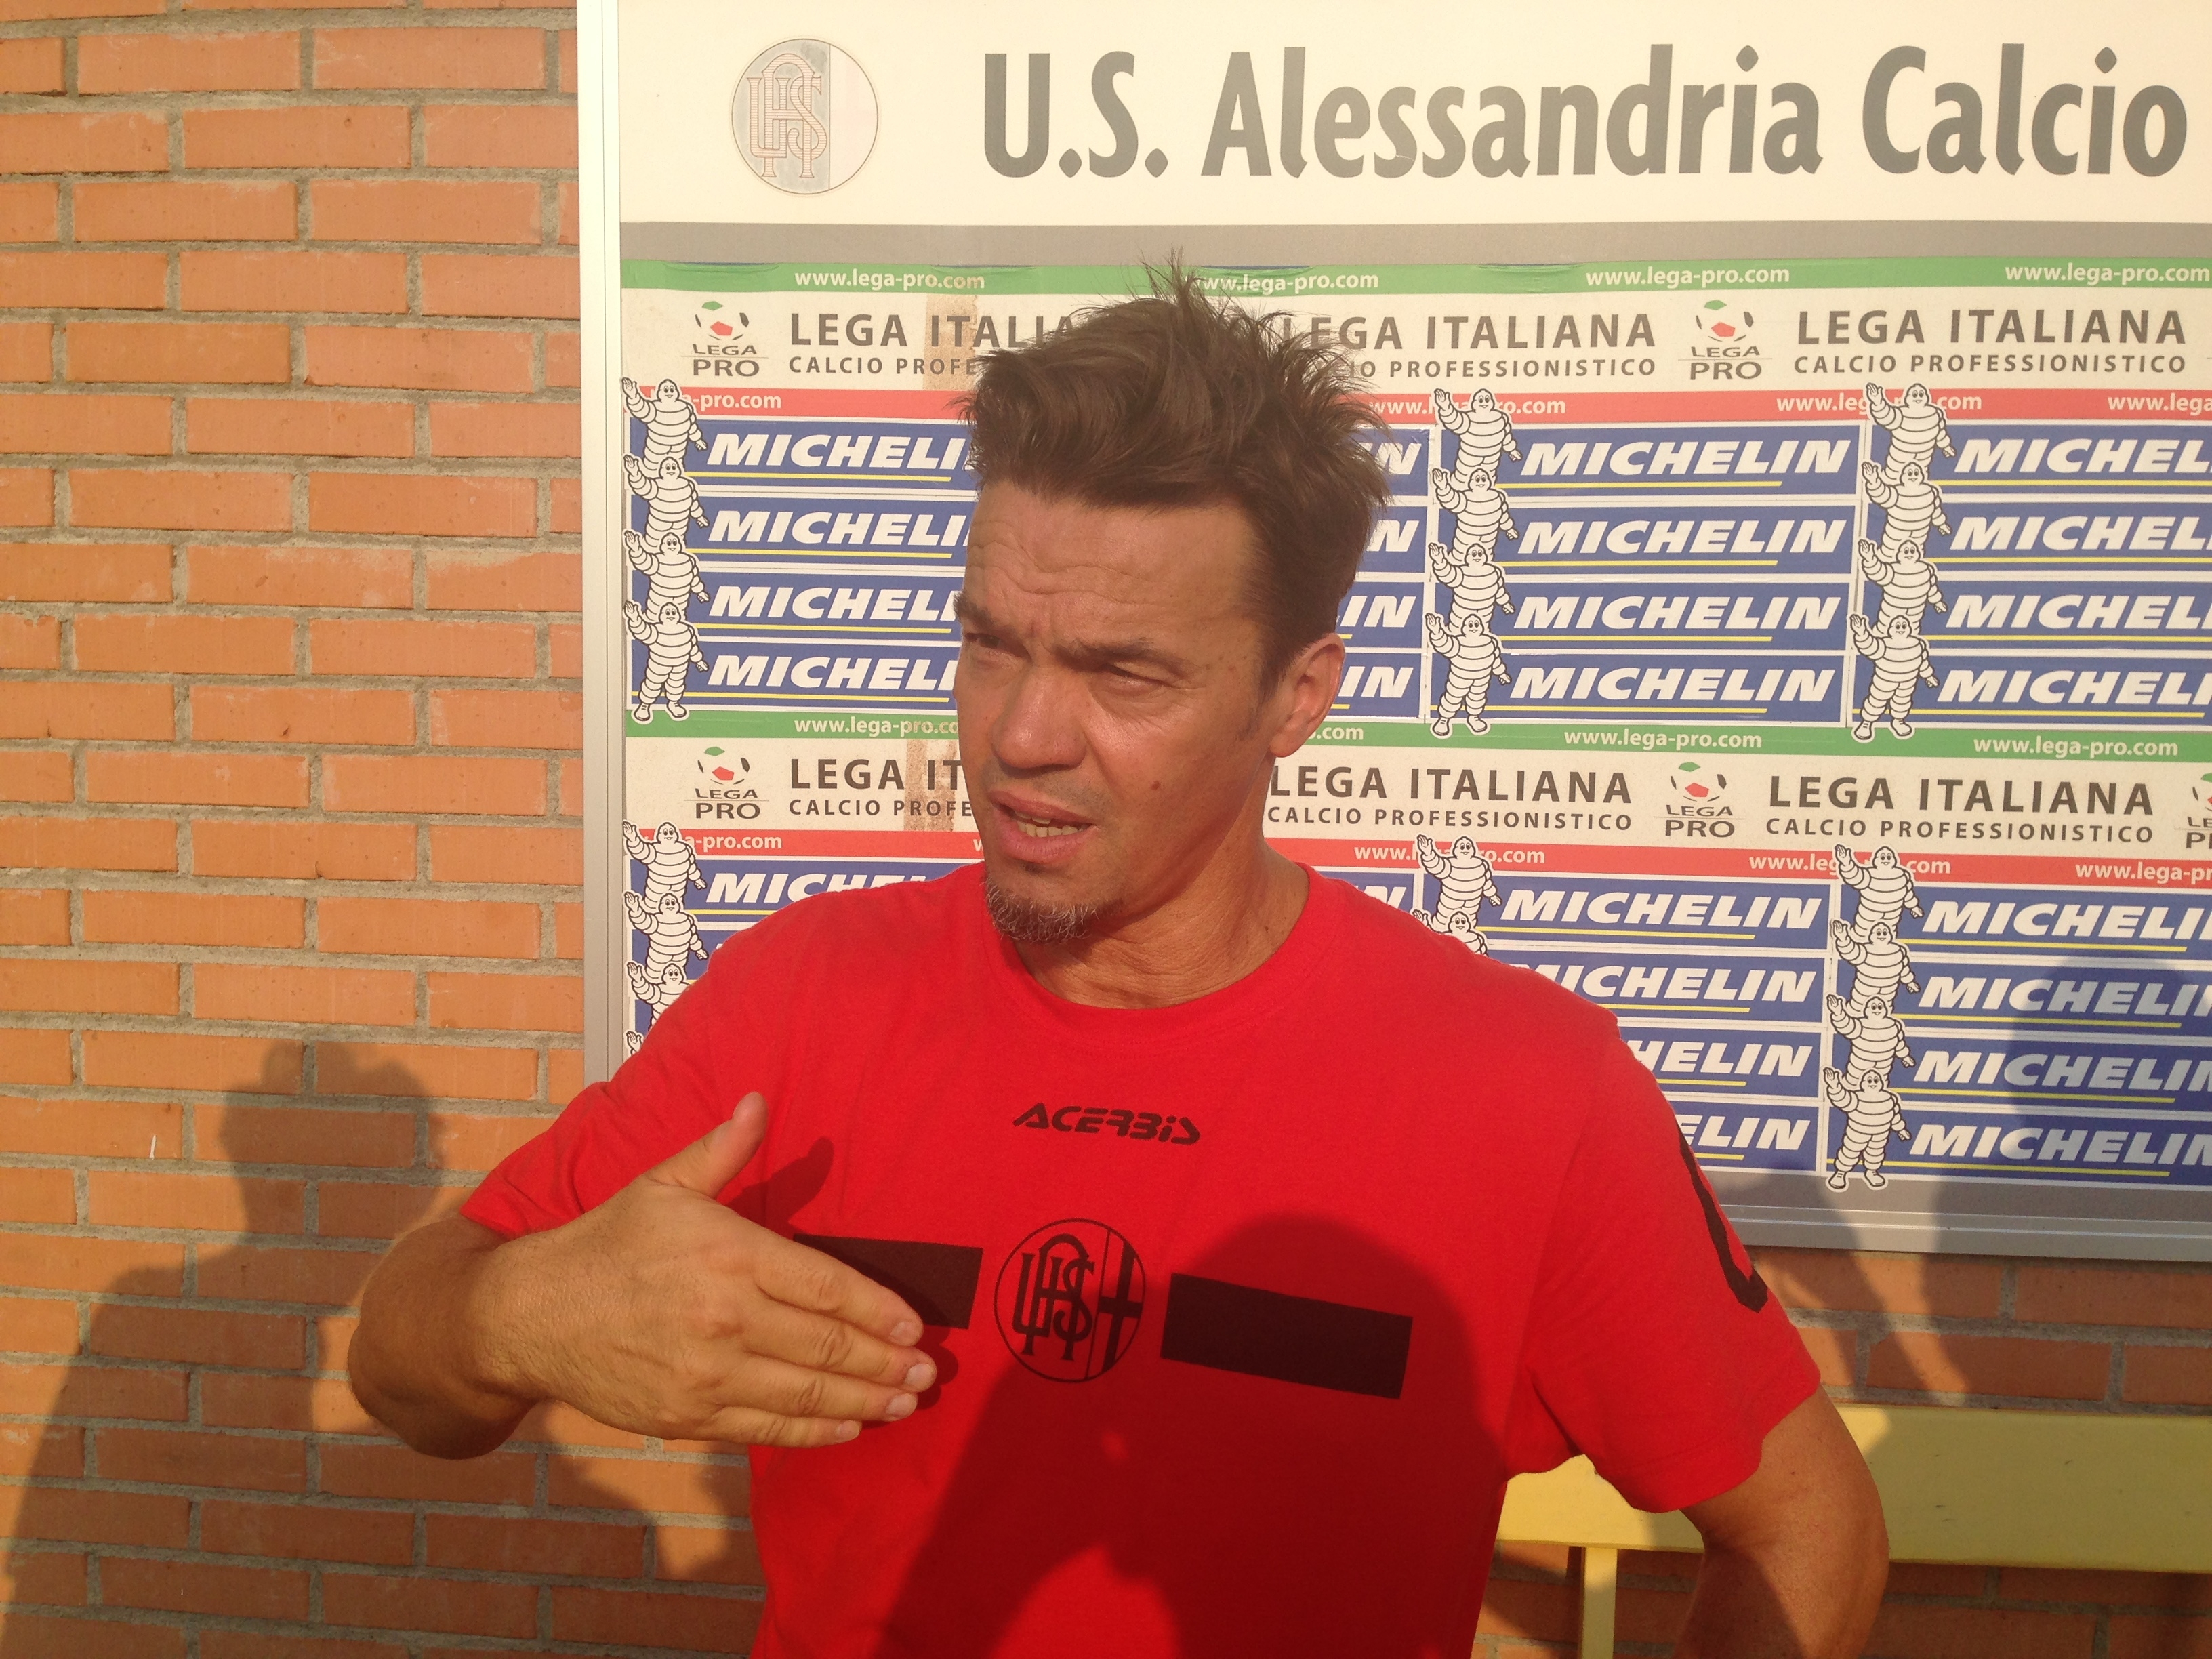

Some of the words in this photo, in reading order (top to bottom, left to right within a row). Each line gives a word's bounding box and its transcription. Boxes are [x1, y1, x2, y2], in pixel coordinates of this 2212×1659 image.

[984, 51, 1168, 178] U.S.
[1201, 44, 1823, 178] Alessandria
[1862, 43, 2187, 177] Calcio
[795, 269, 985, 290] www.lega-pro.com
[1186, 272, 1378, 293] ww.lega-pro.com
[1586, 266, 1790, 289] www.lega-pro.com
[2005, 263, 2209, 285] www.lega-pro.com
[791, 313, 908, 346] LEGA
[1427, 314, 1655, 349] ITALIANA
[1798, 310, 1925, 344] LEGA
[1950, 310, 2186, 344] ITALIANA
[693, 344, 757, 355] LEGA
[1691, 346, 1760, 357] LEGA
[693, 359, 759, 377] PRO
[789, 356, 882, 375] CALCIO
[1390, 358, 1655, 377] PROFESSIONISTICO
[1690, 362, 1762, 380] PRO
[1794, 355, 1896, 373] CALCIO
[1911, 354, 2186, 373] PROFESSIONISTICO
[707, 434, 973, 470] MICHELI
[1521, 440, 1851, 476] MICHELIN
[1954, 438, 2212, 473] MICHEL
[708, 510, 970, 546] MICHELI
[1517, 520, 1847, 554] MICHELIN
[1950, 516, 2212, 550] MICHEL
[1513, 596, 1841, 630] MICHELIN
[1946, 594, 2212, 629] MICHEL
[708, 655, 958, 690] MICHELI
[1510, 667, 1835, 702] MICHELIN
[794, 716, 958, 735] www.lega-pro.co
[1564, 728, 1761, 750] www.lega-pro.com
[1973, 735, 2177, 758] www.lega-pro.com
[791, 758, 904, 790] LEGA
[1271, 765, 1387, 798] LEGA
[1410, 768, 1631, 804] ITALIANA
[695, 788, 758, 799] LEGA
[1769, 775, 1894, 810] LEGA
[1919, 779, 2154, 815] ITALIANA
[695, 802, 760, 819] PRO
[789, 799, 880, 816] CALCIO
[1267, 806, 1361, 825] CALCIO
[1374, 809, 1631, 831] PROFESSIONISTICO
[1666, 804, 1734, 817] LEGA
[1664, 820, 1735, 838] PRO
[1766, 818, 1866, 837] CALCIO
[1880, 821, 2153, 843] PROFESSIONISTICO
[1501, 889, 1822, 929] MICHELIN
[1922, 901, 2212, 941] MICHELI
